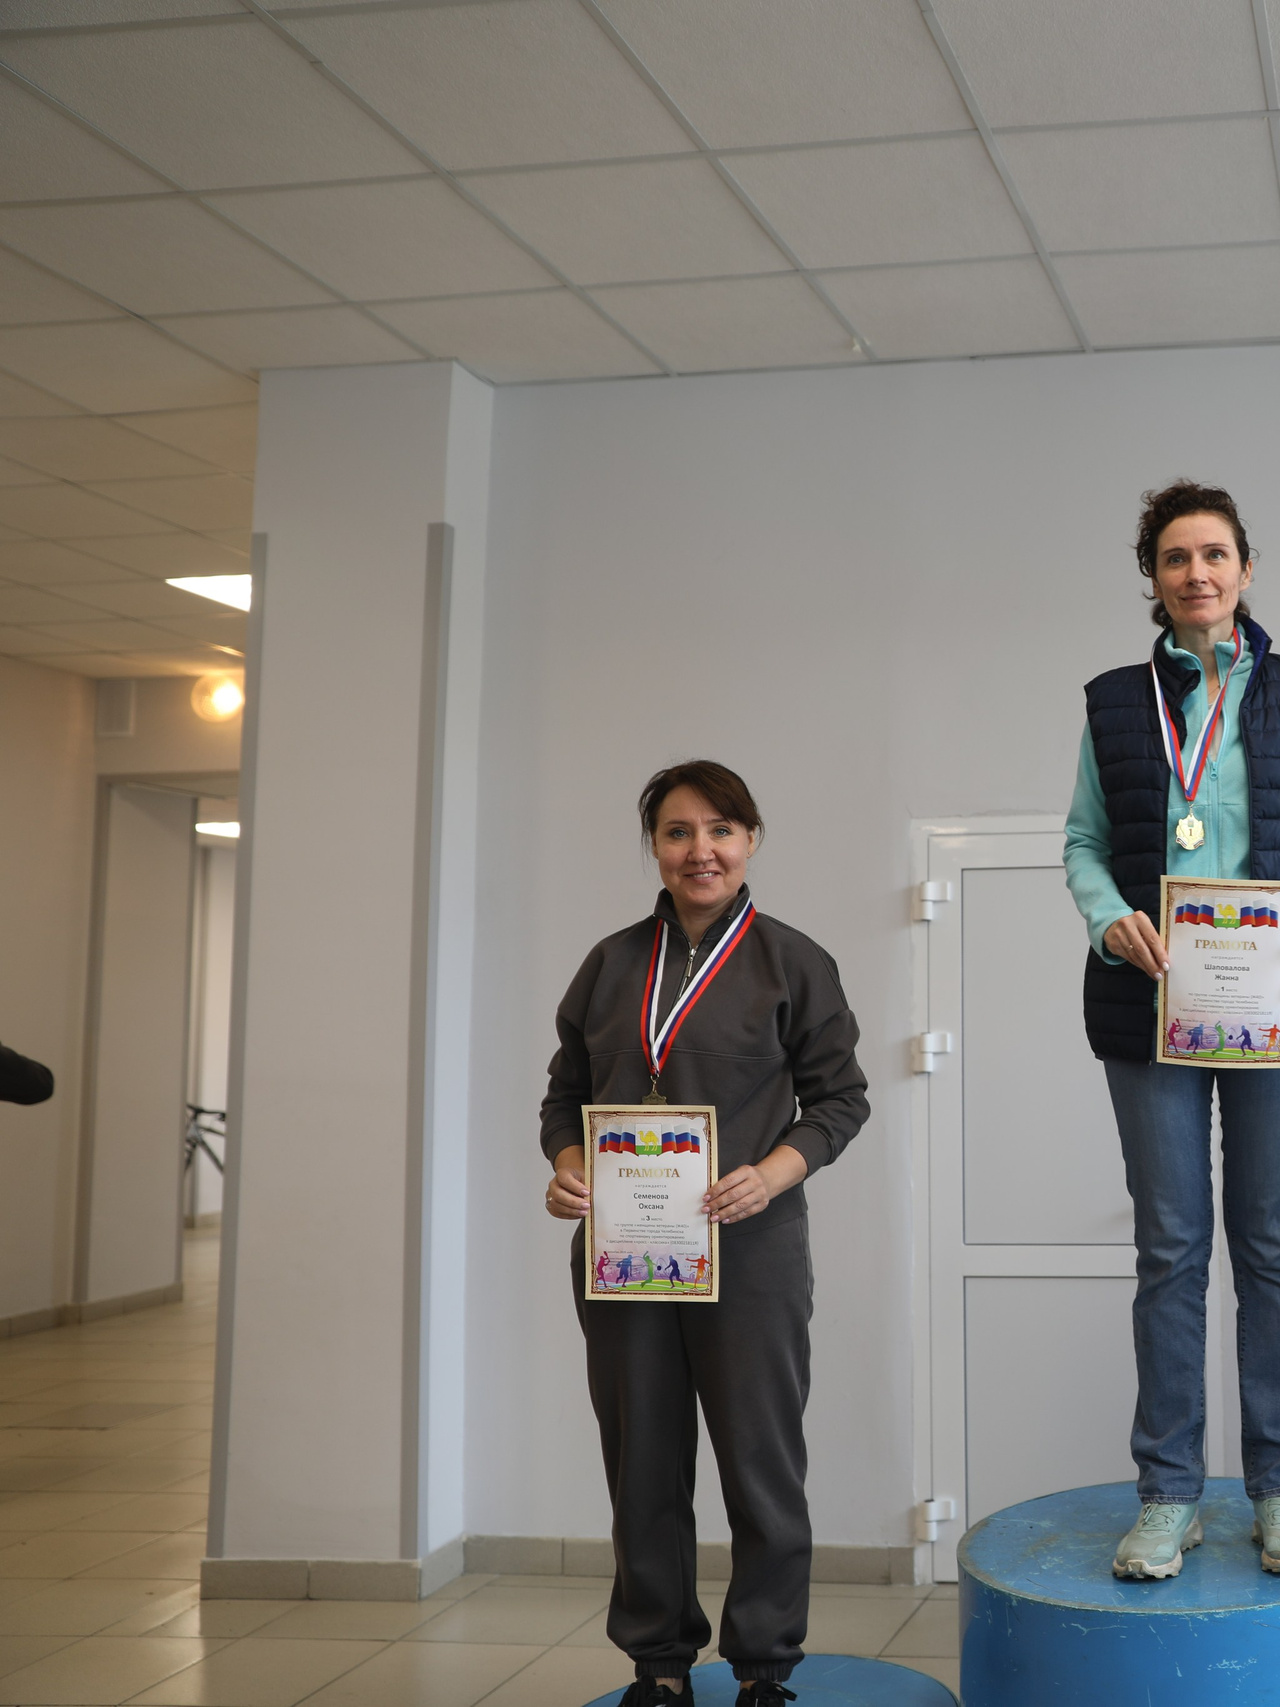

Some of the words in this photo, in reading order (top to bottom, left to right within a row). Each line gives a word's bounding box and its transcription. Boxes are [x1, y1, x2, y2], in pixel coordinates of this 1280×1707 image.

[1195, 939, 1258, 951] ГРАМОТА
[1204, 963, 1250, 972] Шаповалова
[618, 1168, 680, 1177] ГРАМОТА
[633, 1192, 669, 1200] Семенова
[638, 1202, 664, 1210] Оксана
